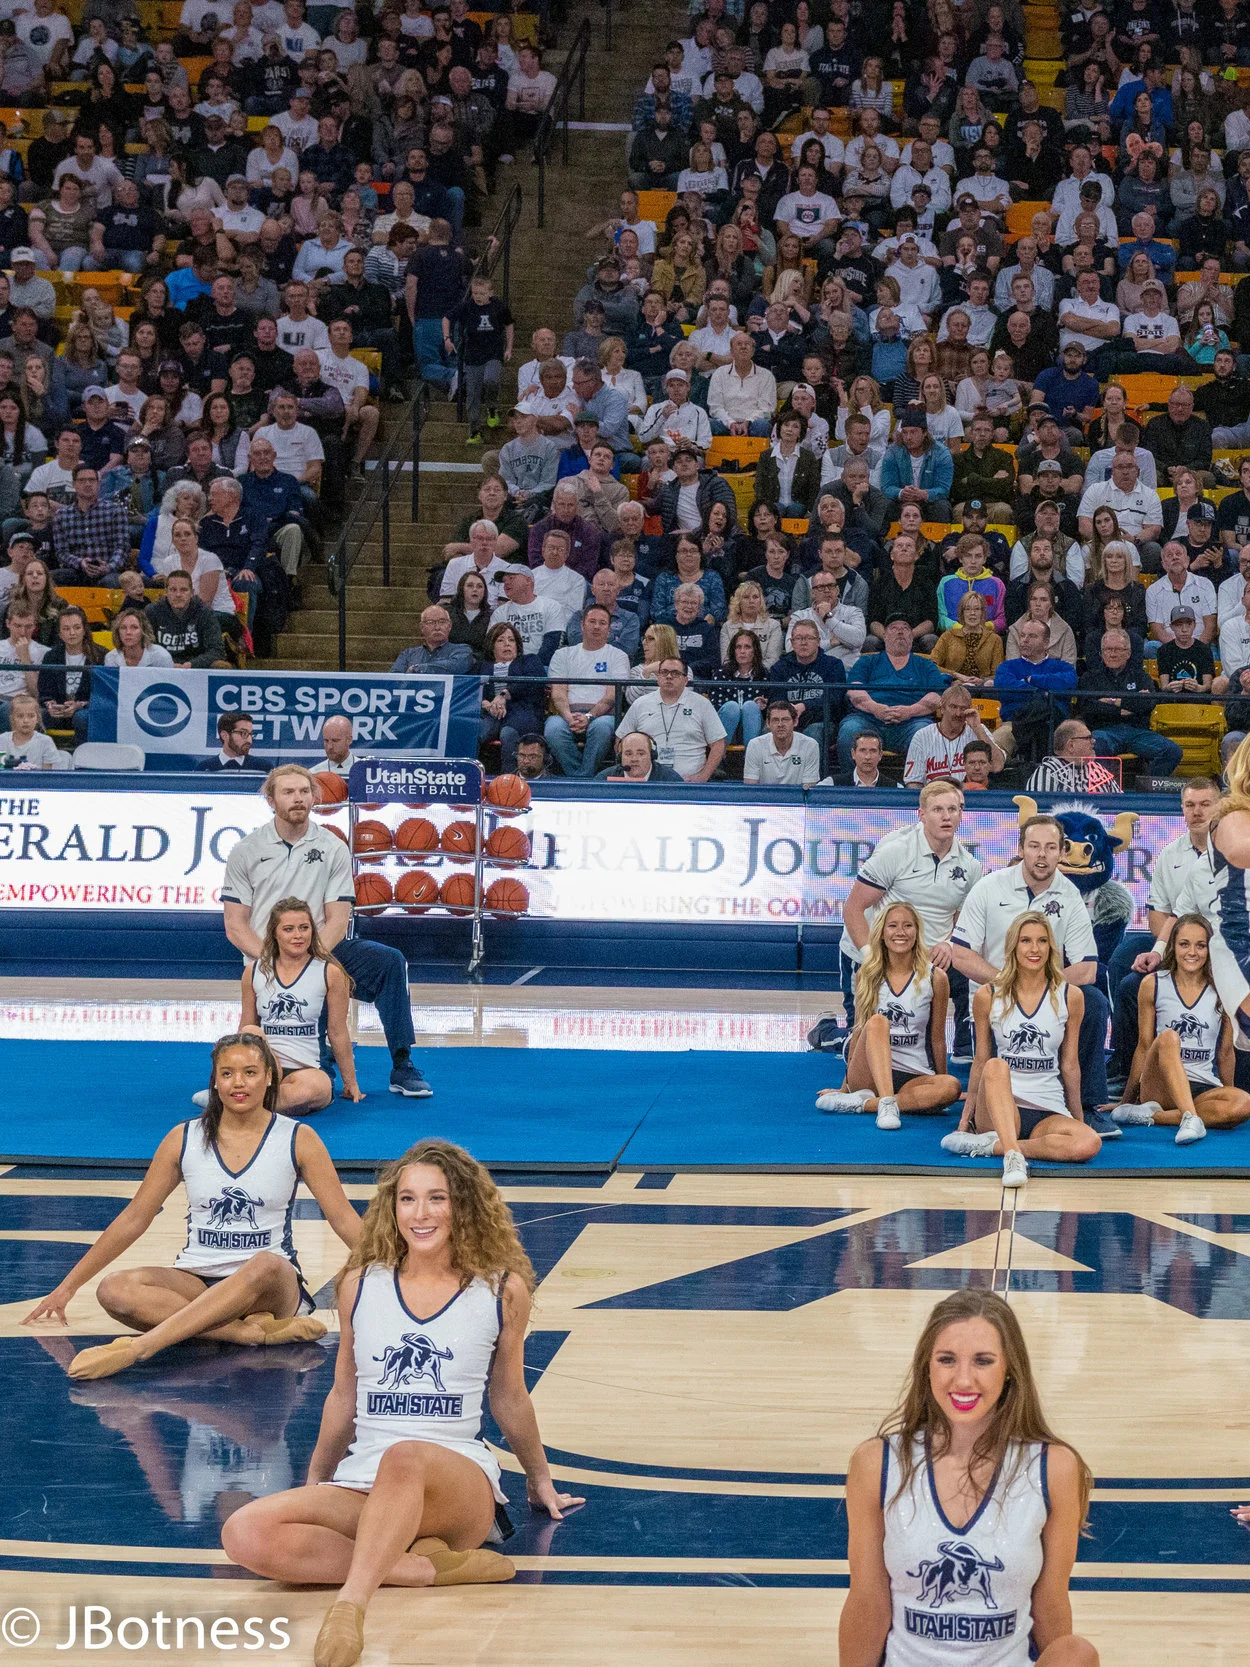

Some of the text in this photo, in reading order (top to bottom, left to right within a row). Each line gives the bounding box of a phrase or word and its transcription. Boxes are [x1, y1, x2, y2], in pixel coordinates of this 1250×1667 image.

[215, 684, 436, 714] CBS SPORTS
[904, 761, 912, 778] 7
[925, 754, 949, 773] Mud
[366, 767, 467, 786] UtahState
[365, 785, 468, 796] BASKETBALL
[0, 798, 40, 816] THE
[159, 886, 205, 904] THE
[716, 896, 760, 914] THE
[264, 1024, 316, 1036] UTAH STATE
[892, 1034, 918, 1046] STATE
[1026, 1056, 1054, 1070] STATE
[1184, 1049, 1210, 1061] STATE
[198, 1229, 272, 1249] UTAH STATE
[367, 1392, 464, 1418] UTAH STATE
[904, 1607, 1017, 1642] UTAH STATE
